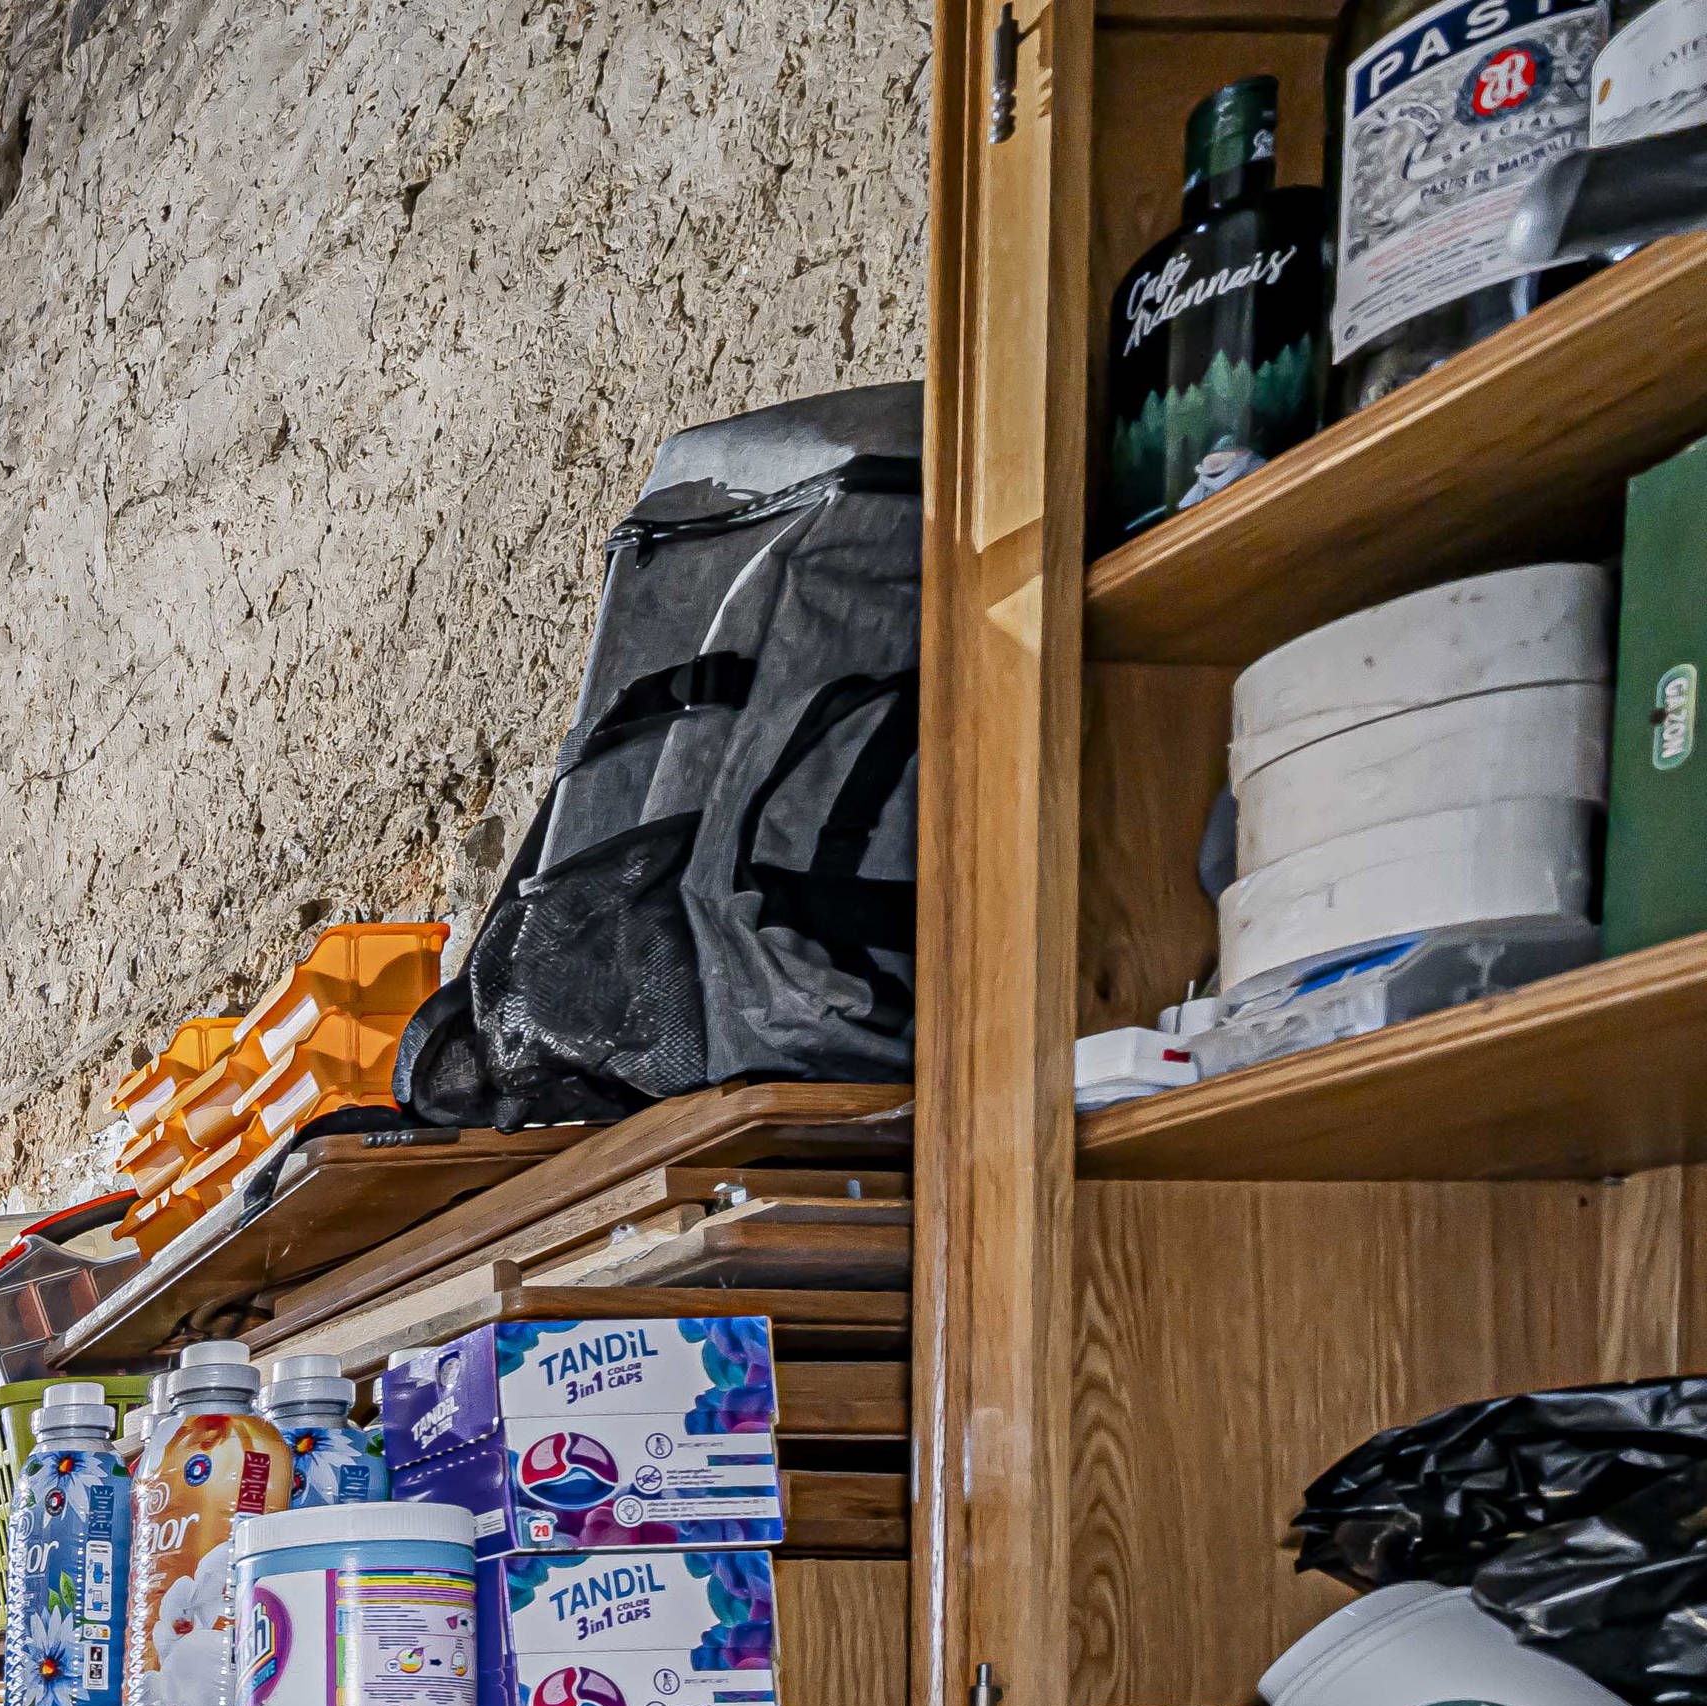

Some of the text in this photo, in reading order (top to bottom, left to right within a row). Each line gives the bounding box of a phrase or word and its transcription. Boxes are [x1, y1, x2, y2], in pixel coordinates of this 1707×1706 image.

[1126, 251, 1191, 320] Café
[1661, 677, 1689, 759] GAZON
[606, 1361, 643, 1377] COLOR
[565, 1371, 605, 1405] 3in1
[608, 1371, 644, 1390] CAPS
[533, 1524, 550, 1538] 20
[616, 1597, 651, 1612] COLOR
[576, 1606, 614, 1641] 3in1
[617, 1607, 652, 1626] CAPS
